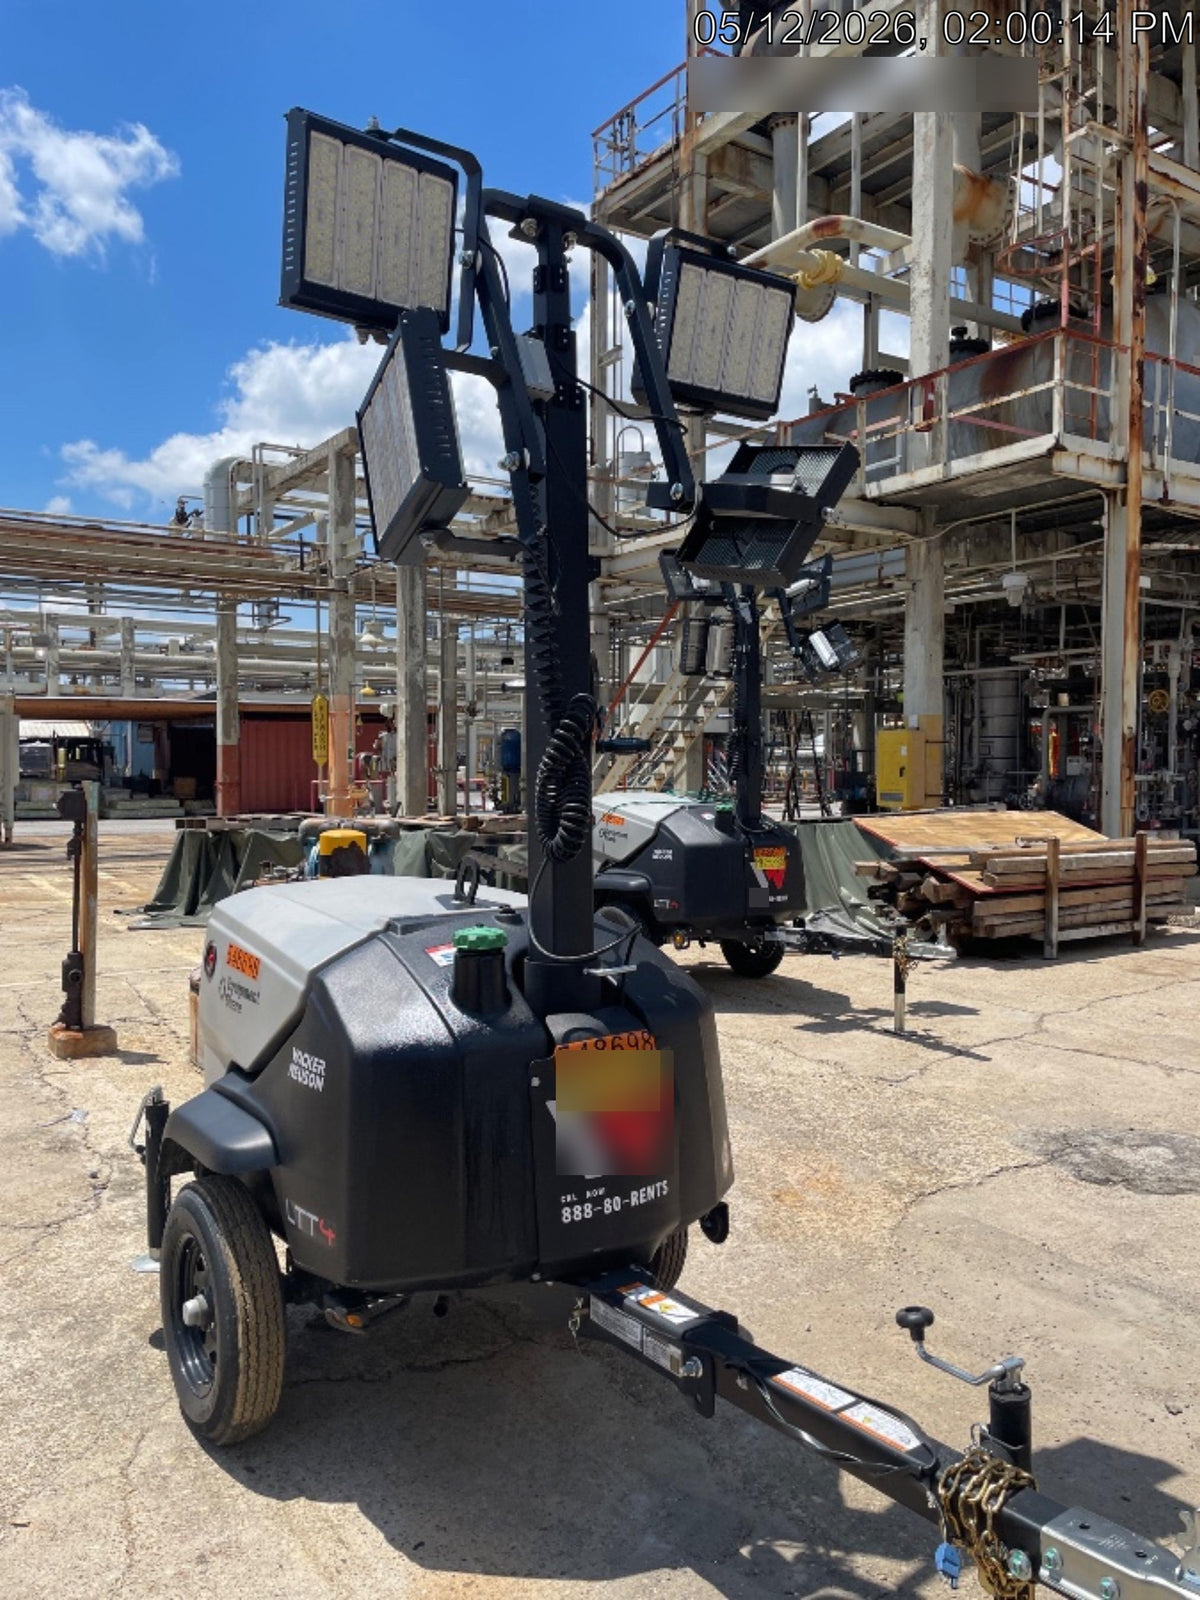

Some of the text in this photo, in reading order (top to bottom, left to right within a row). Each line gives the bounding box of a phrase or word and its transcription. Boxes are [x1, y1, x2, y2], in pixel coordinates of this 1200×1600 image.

[292, 1046, 326, 1076] WACKER
[287, 1062, 325, 1092] NEUSON
[561, 1180, 668, 1224] 888-80-RENTS
